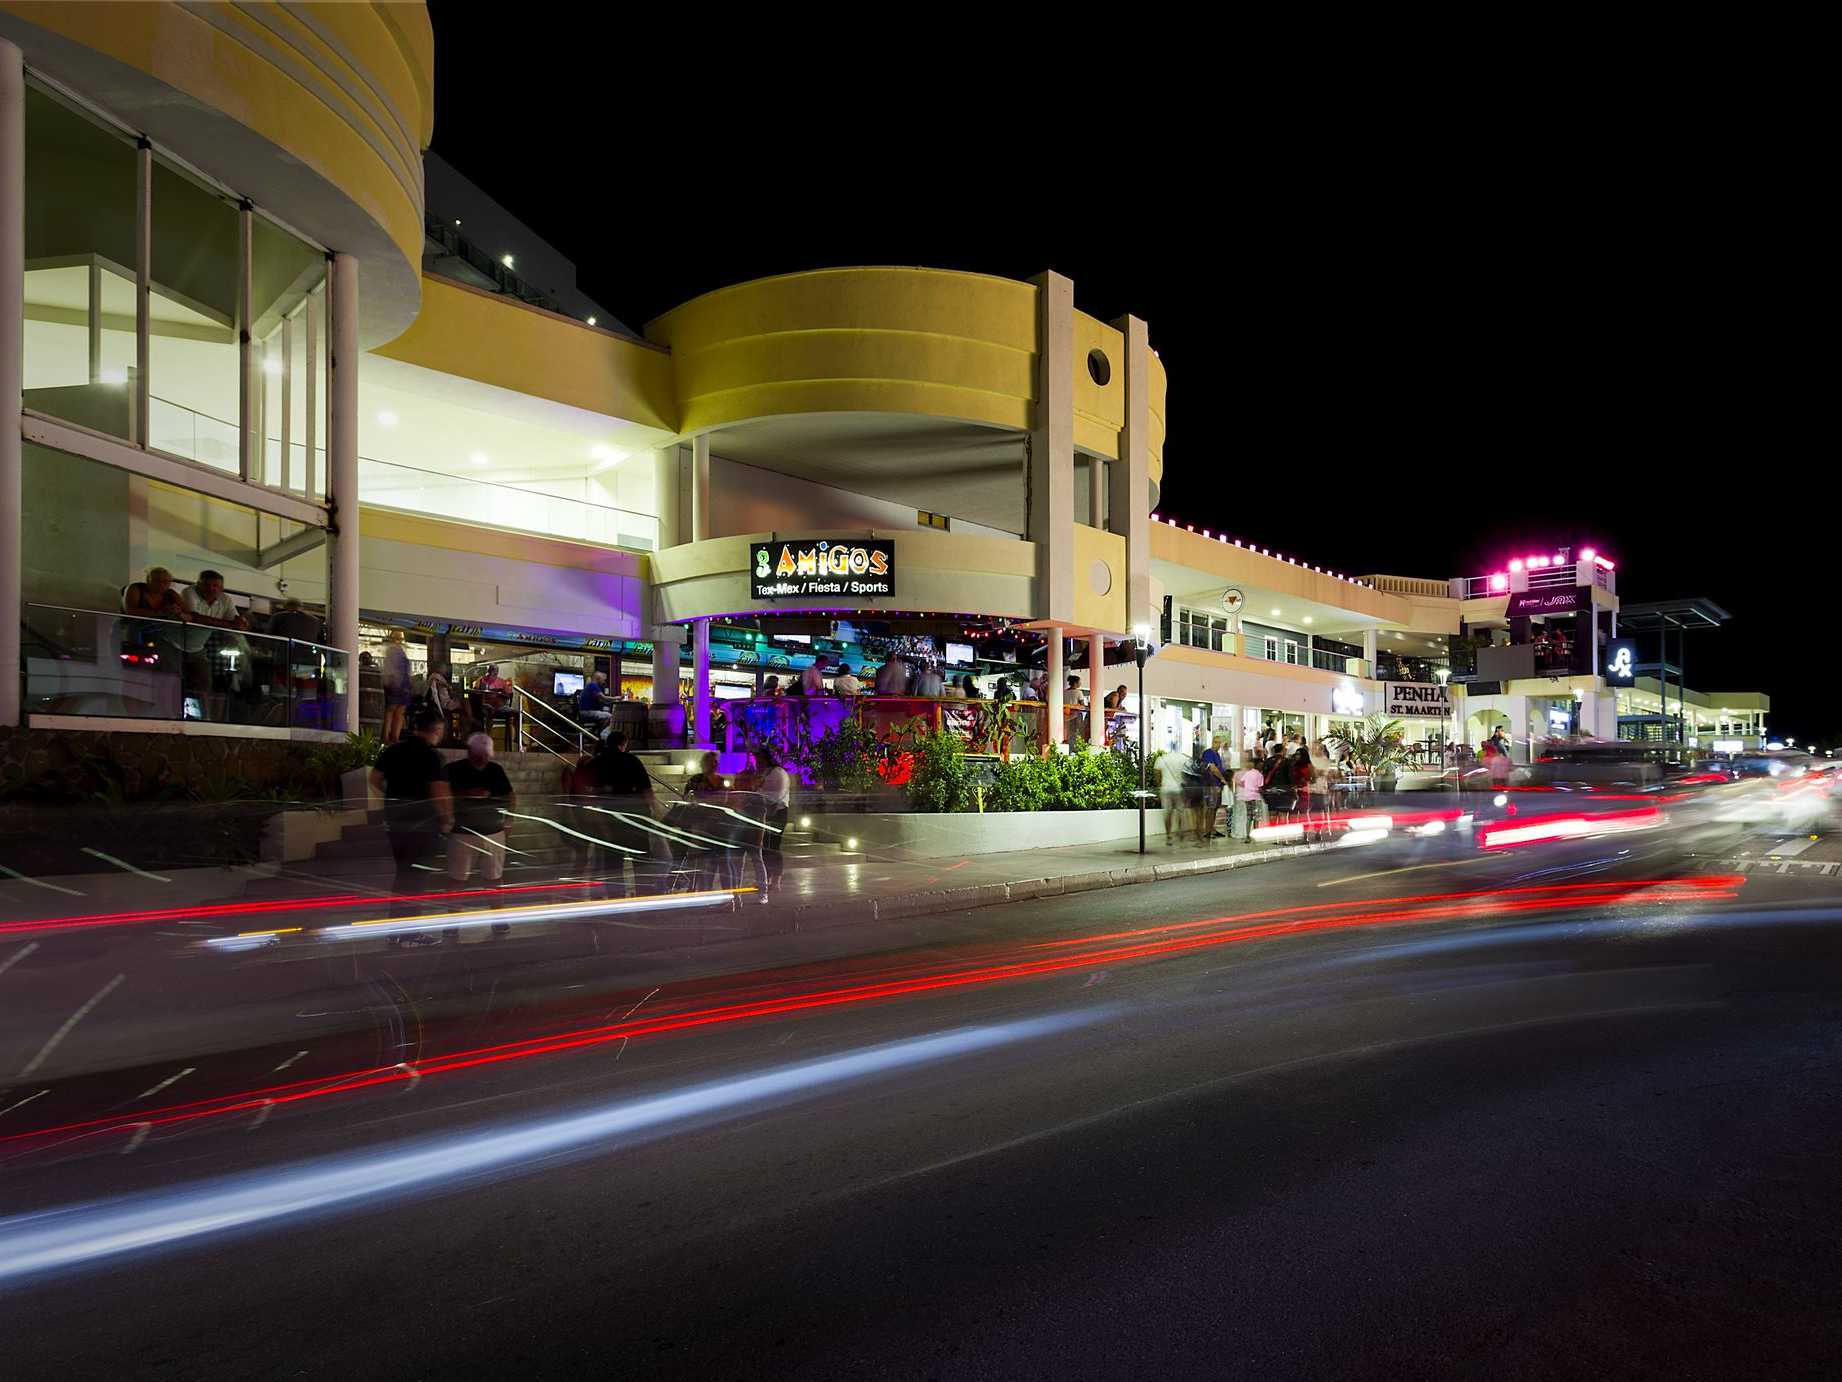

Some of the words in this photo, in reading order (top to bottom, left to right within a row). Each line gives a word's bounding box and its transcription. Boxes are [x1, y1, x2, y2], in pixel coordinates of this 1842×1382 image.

[756, 583, 799, 595] Tex-Mex
[808, 582, 841, 593] Fiesta
[851, 582, 888, 594] Sports
